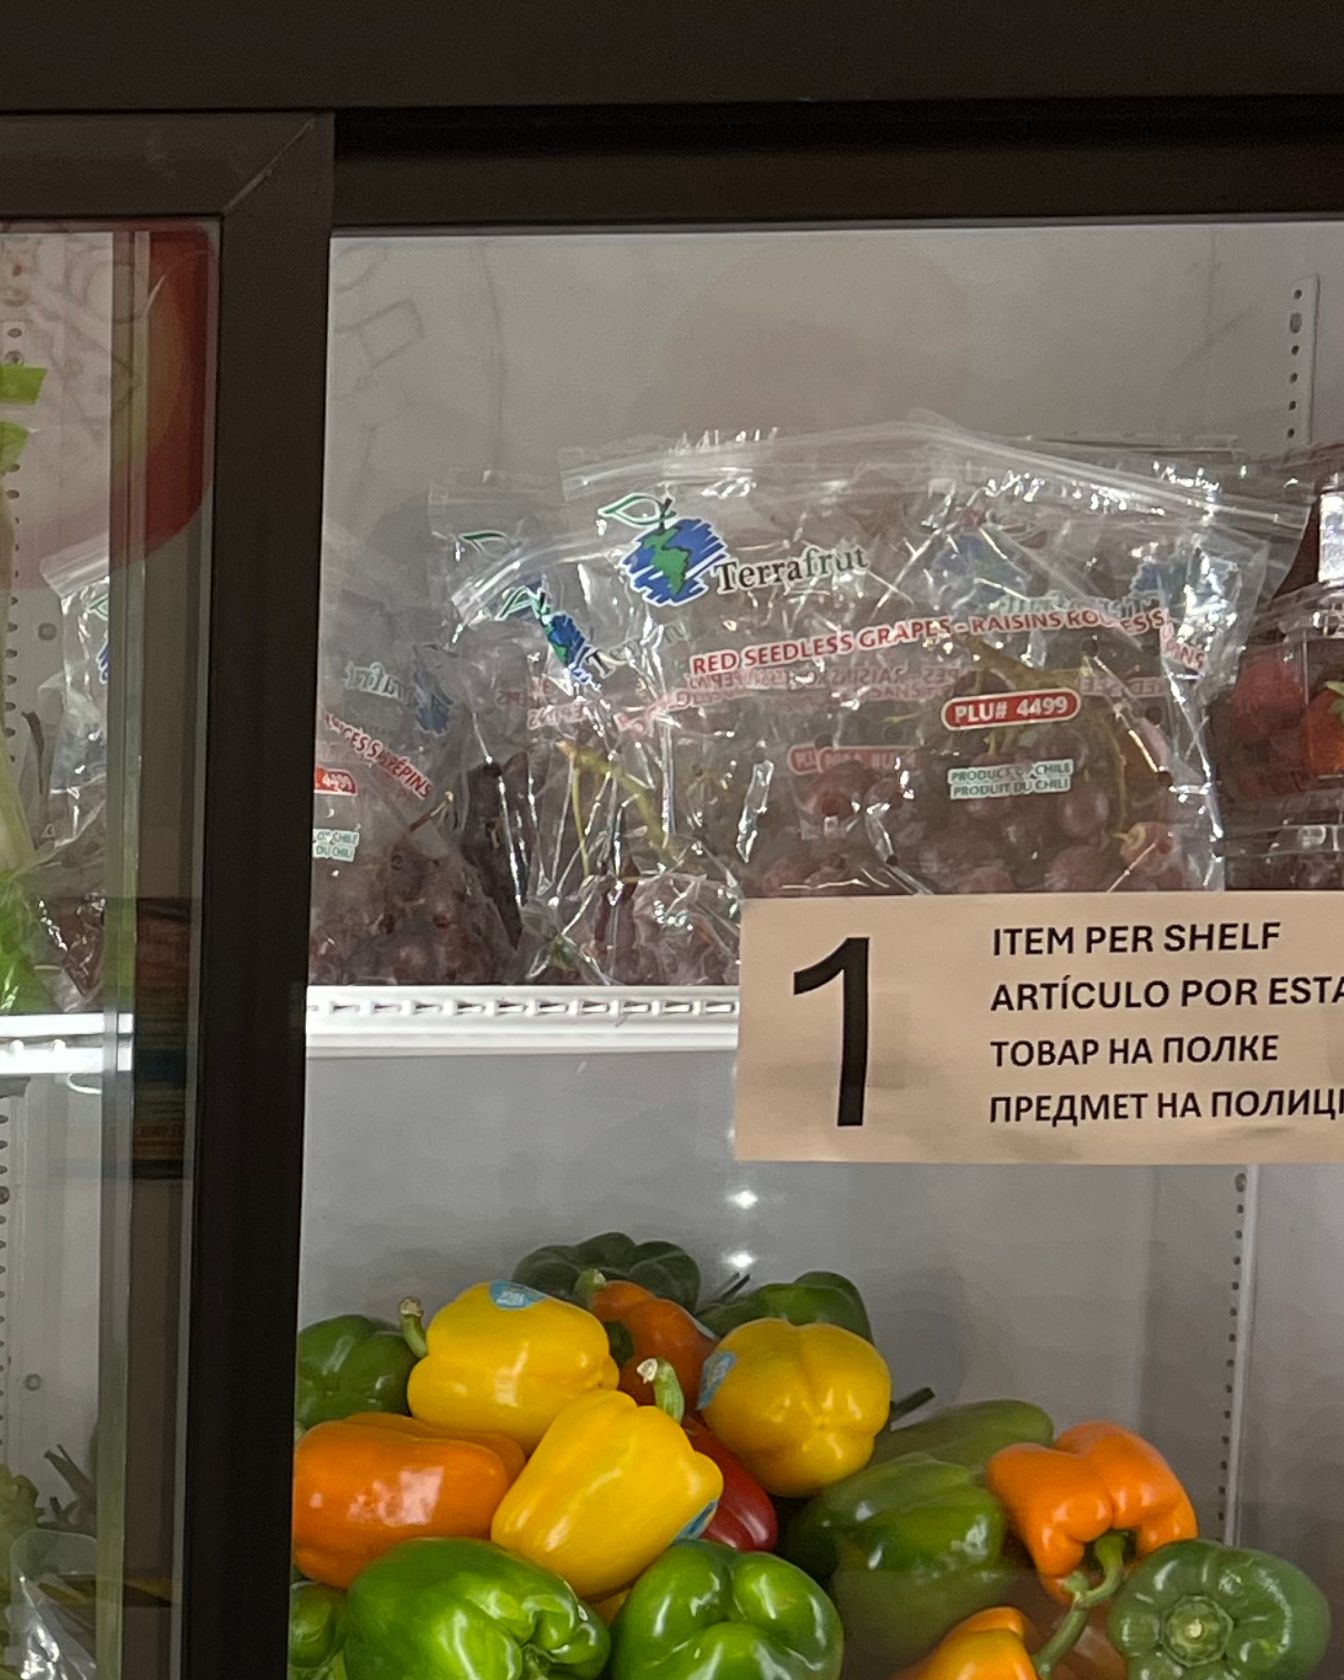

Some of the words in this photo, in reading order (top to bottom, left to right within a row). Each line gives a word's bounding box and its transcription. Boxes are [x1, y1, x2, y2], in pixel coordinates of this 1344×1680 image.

[714, 547, 868, 593] Terrafrut
[692, 652, 738, 674] RED
[744, 633, 854, 666] SEEDLESS
[858, 616, 952, 650] GRAPES
[970, 611, 1062, 635] RAISINS
[954, 700, 1008, 723] PLU#
[1016, 697, 1068, 717] 4499
[951, 766, 1012, 782] PRODUCT
[1034, 763, 1072, 776] CHILE
[952, 781, 1013, 796] PRODUIT
[1014, 780, 1031, 793] DU
[1033, 778, 1069, 792] CHILI
[992, 927, 1075, 956] ITEM
[1085, 925, 1155, 954] PER
[1164, 922, 1282, 951] SHELF
[989, 975, 1170, 1012] ARTÍCULO
[1180, 979, 1258, 1007] POR
[792, 935, 872, 1127] 1
[991, 1039, 1099, 1067] ТОВАР
[1109, 1038, 1153, 1064] НА
[1162, 1035, 1279, 1063] ПОЛКЕ
[989, 1094, 1147, 1128] ПРЕДМЕТ
[1157, 1092, 1199, 1119] НА
